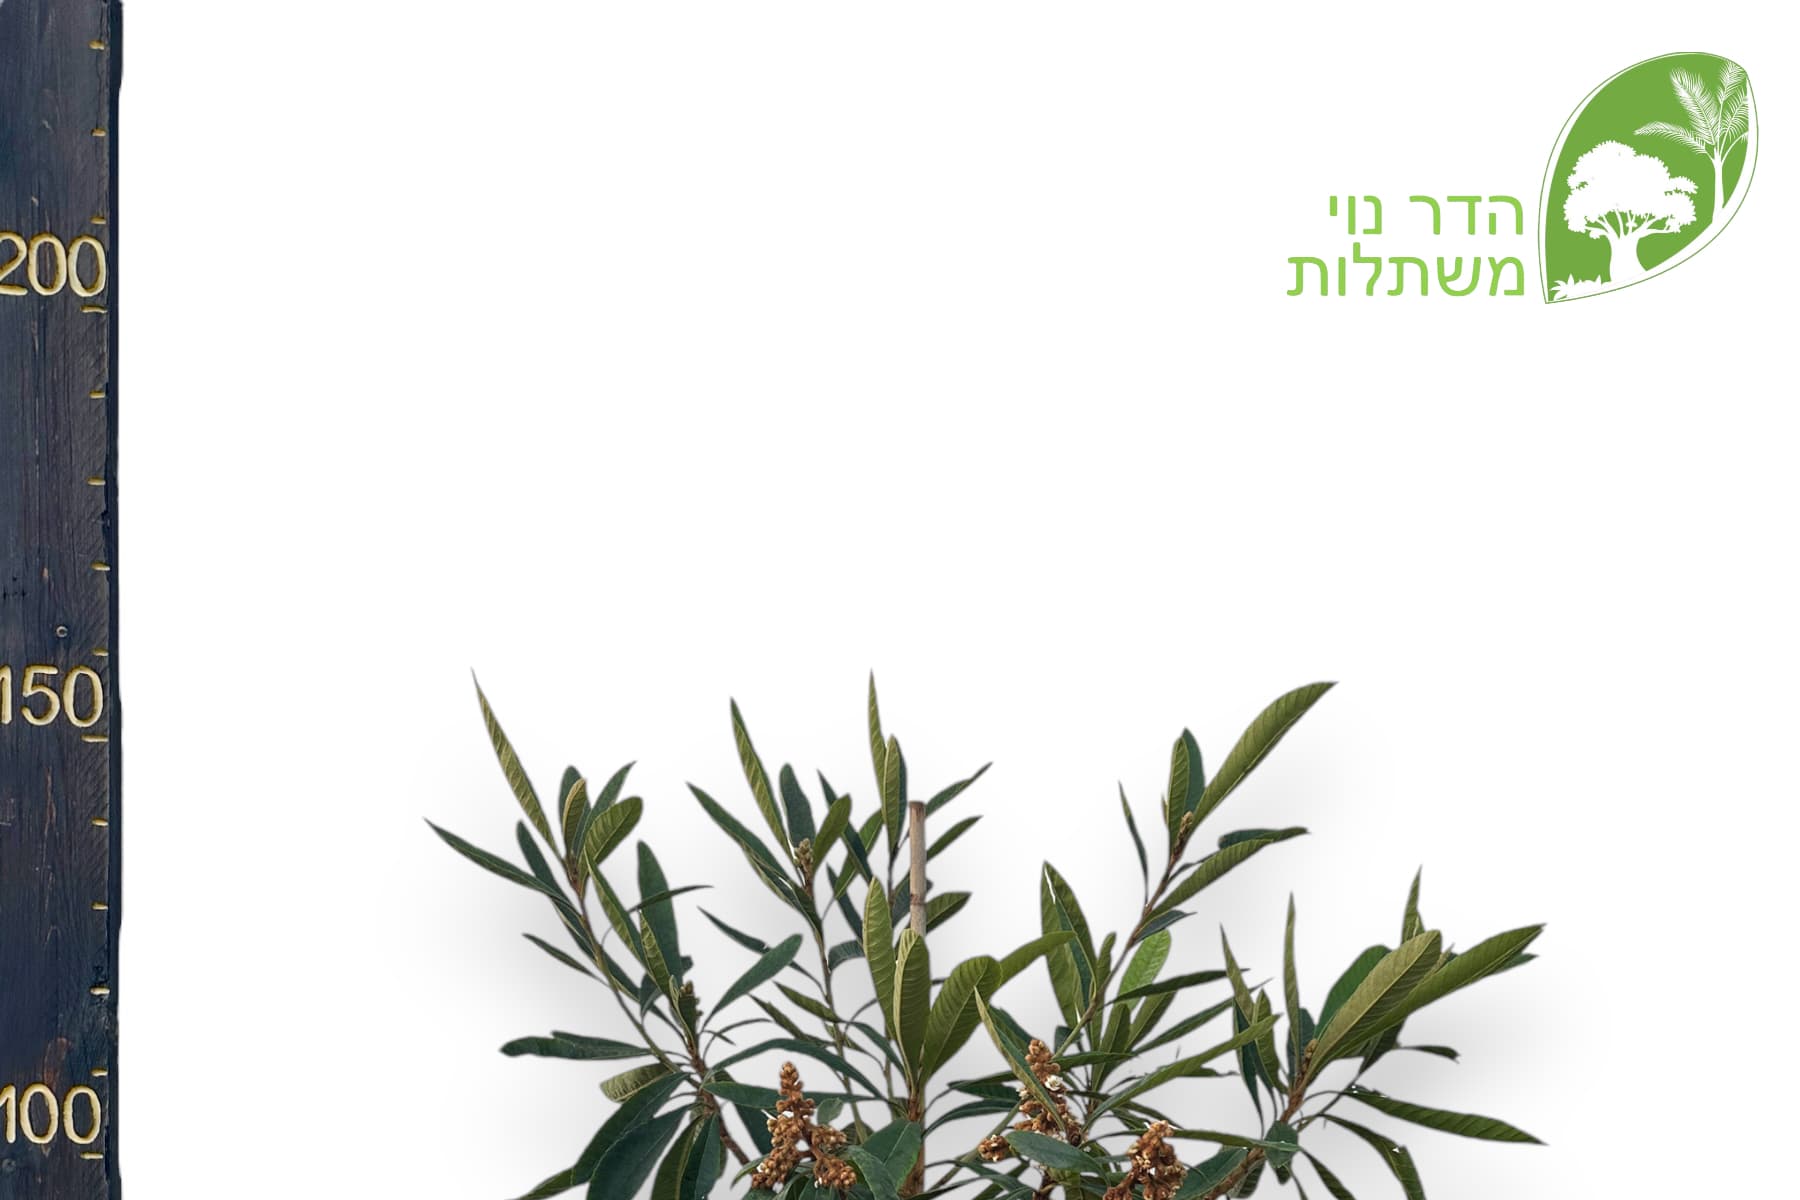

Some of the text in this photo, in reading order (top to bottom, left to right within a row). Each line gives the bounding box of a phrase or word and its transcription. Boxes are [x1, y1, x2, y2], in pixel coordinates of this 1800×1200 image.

[0, 231, 107, 297] 200
[0, 664, 104, 728] 150
[0, 1083, 101, 1145] 100
